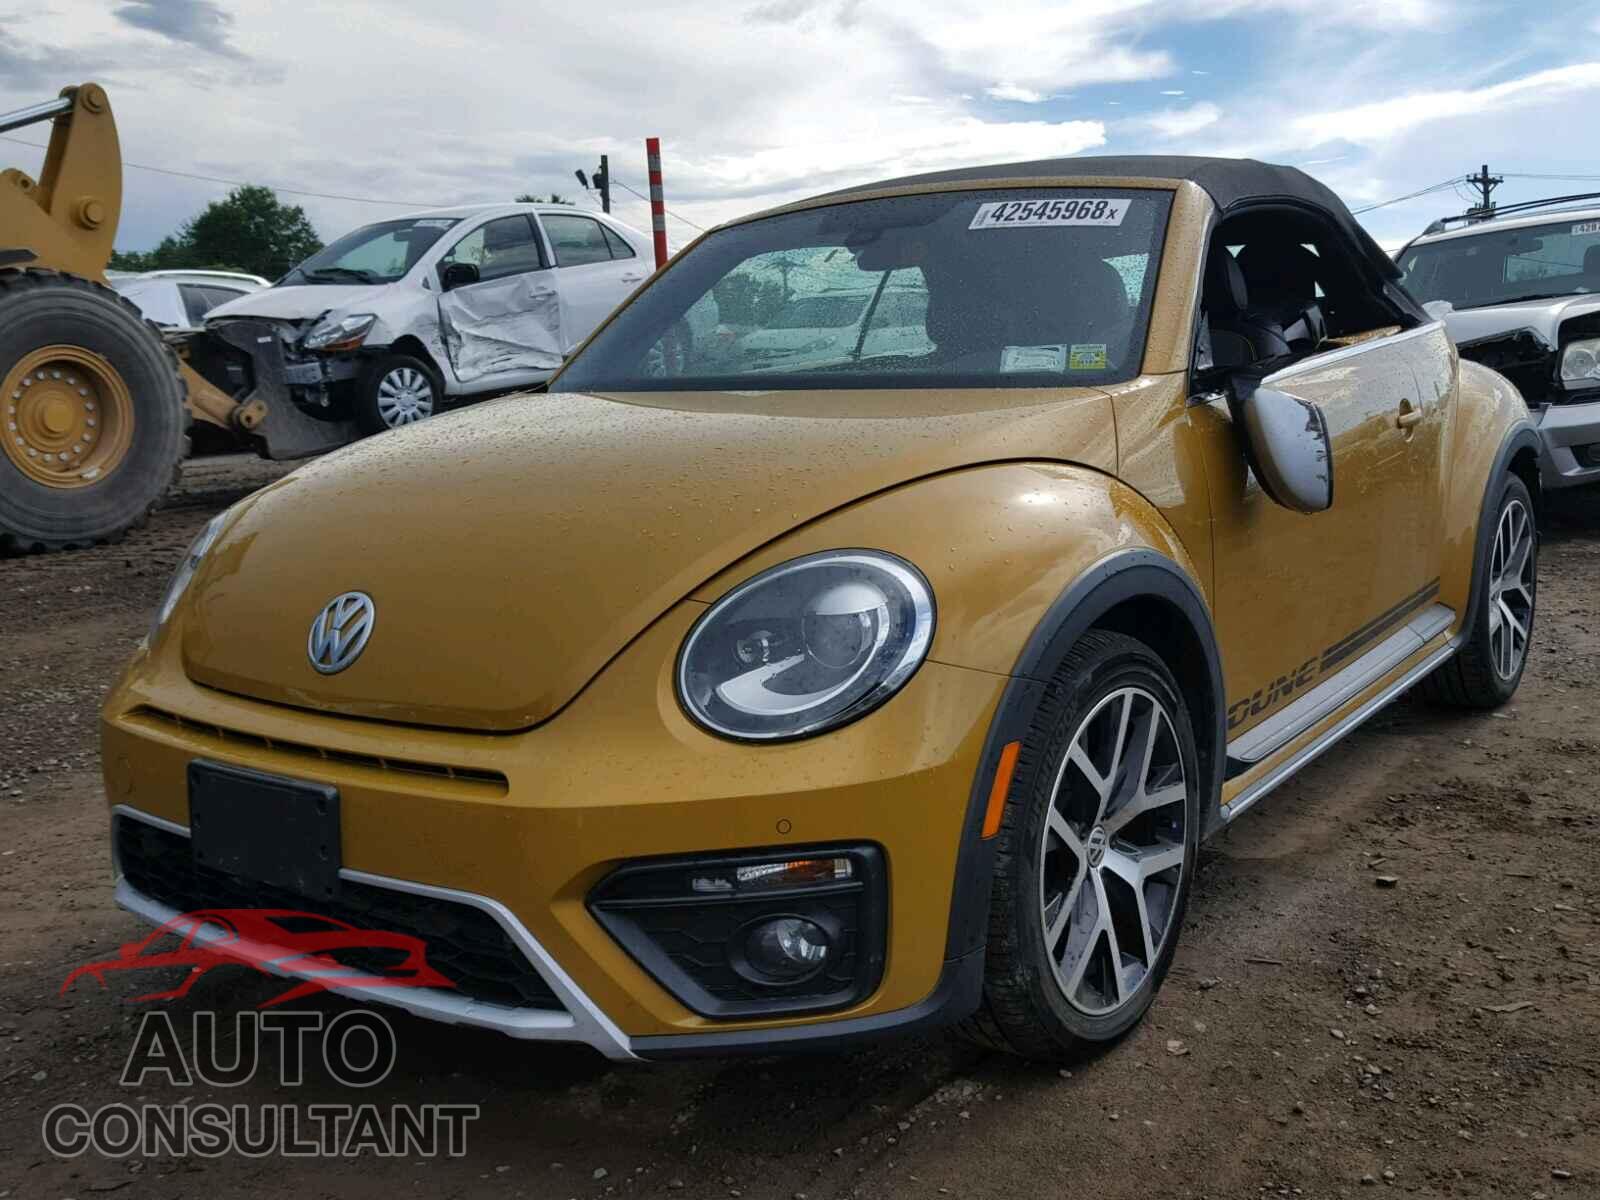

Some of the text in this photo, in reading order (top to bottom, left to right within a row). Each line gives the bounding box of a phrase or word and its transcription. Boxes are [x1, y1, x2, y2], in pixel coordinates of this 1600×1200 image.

[990, 200, 1109, 222] 42545968
[308, 591, 375, 672] VW
[1227, 657, 1318, 730] DUNE
